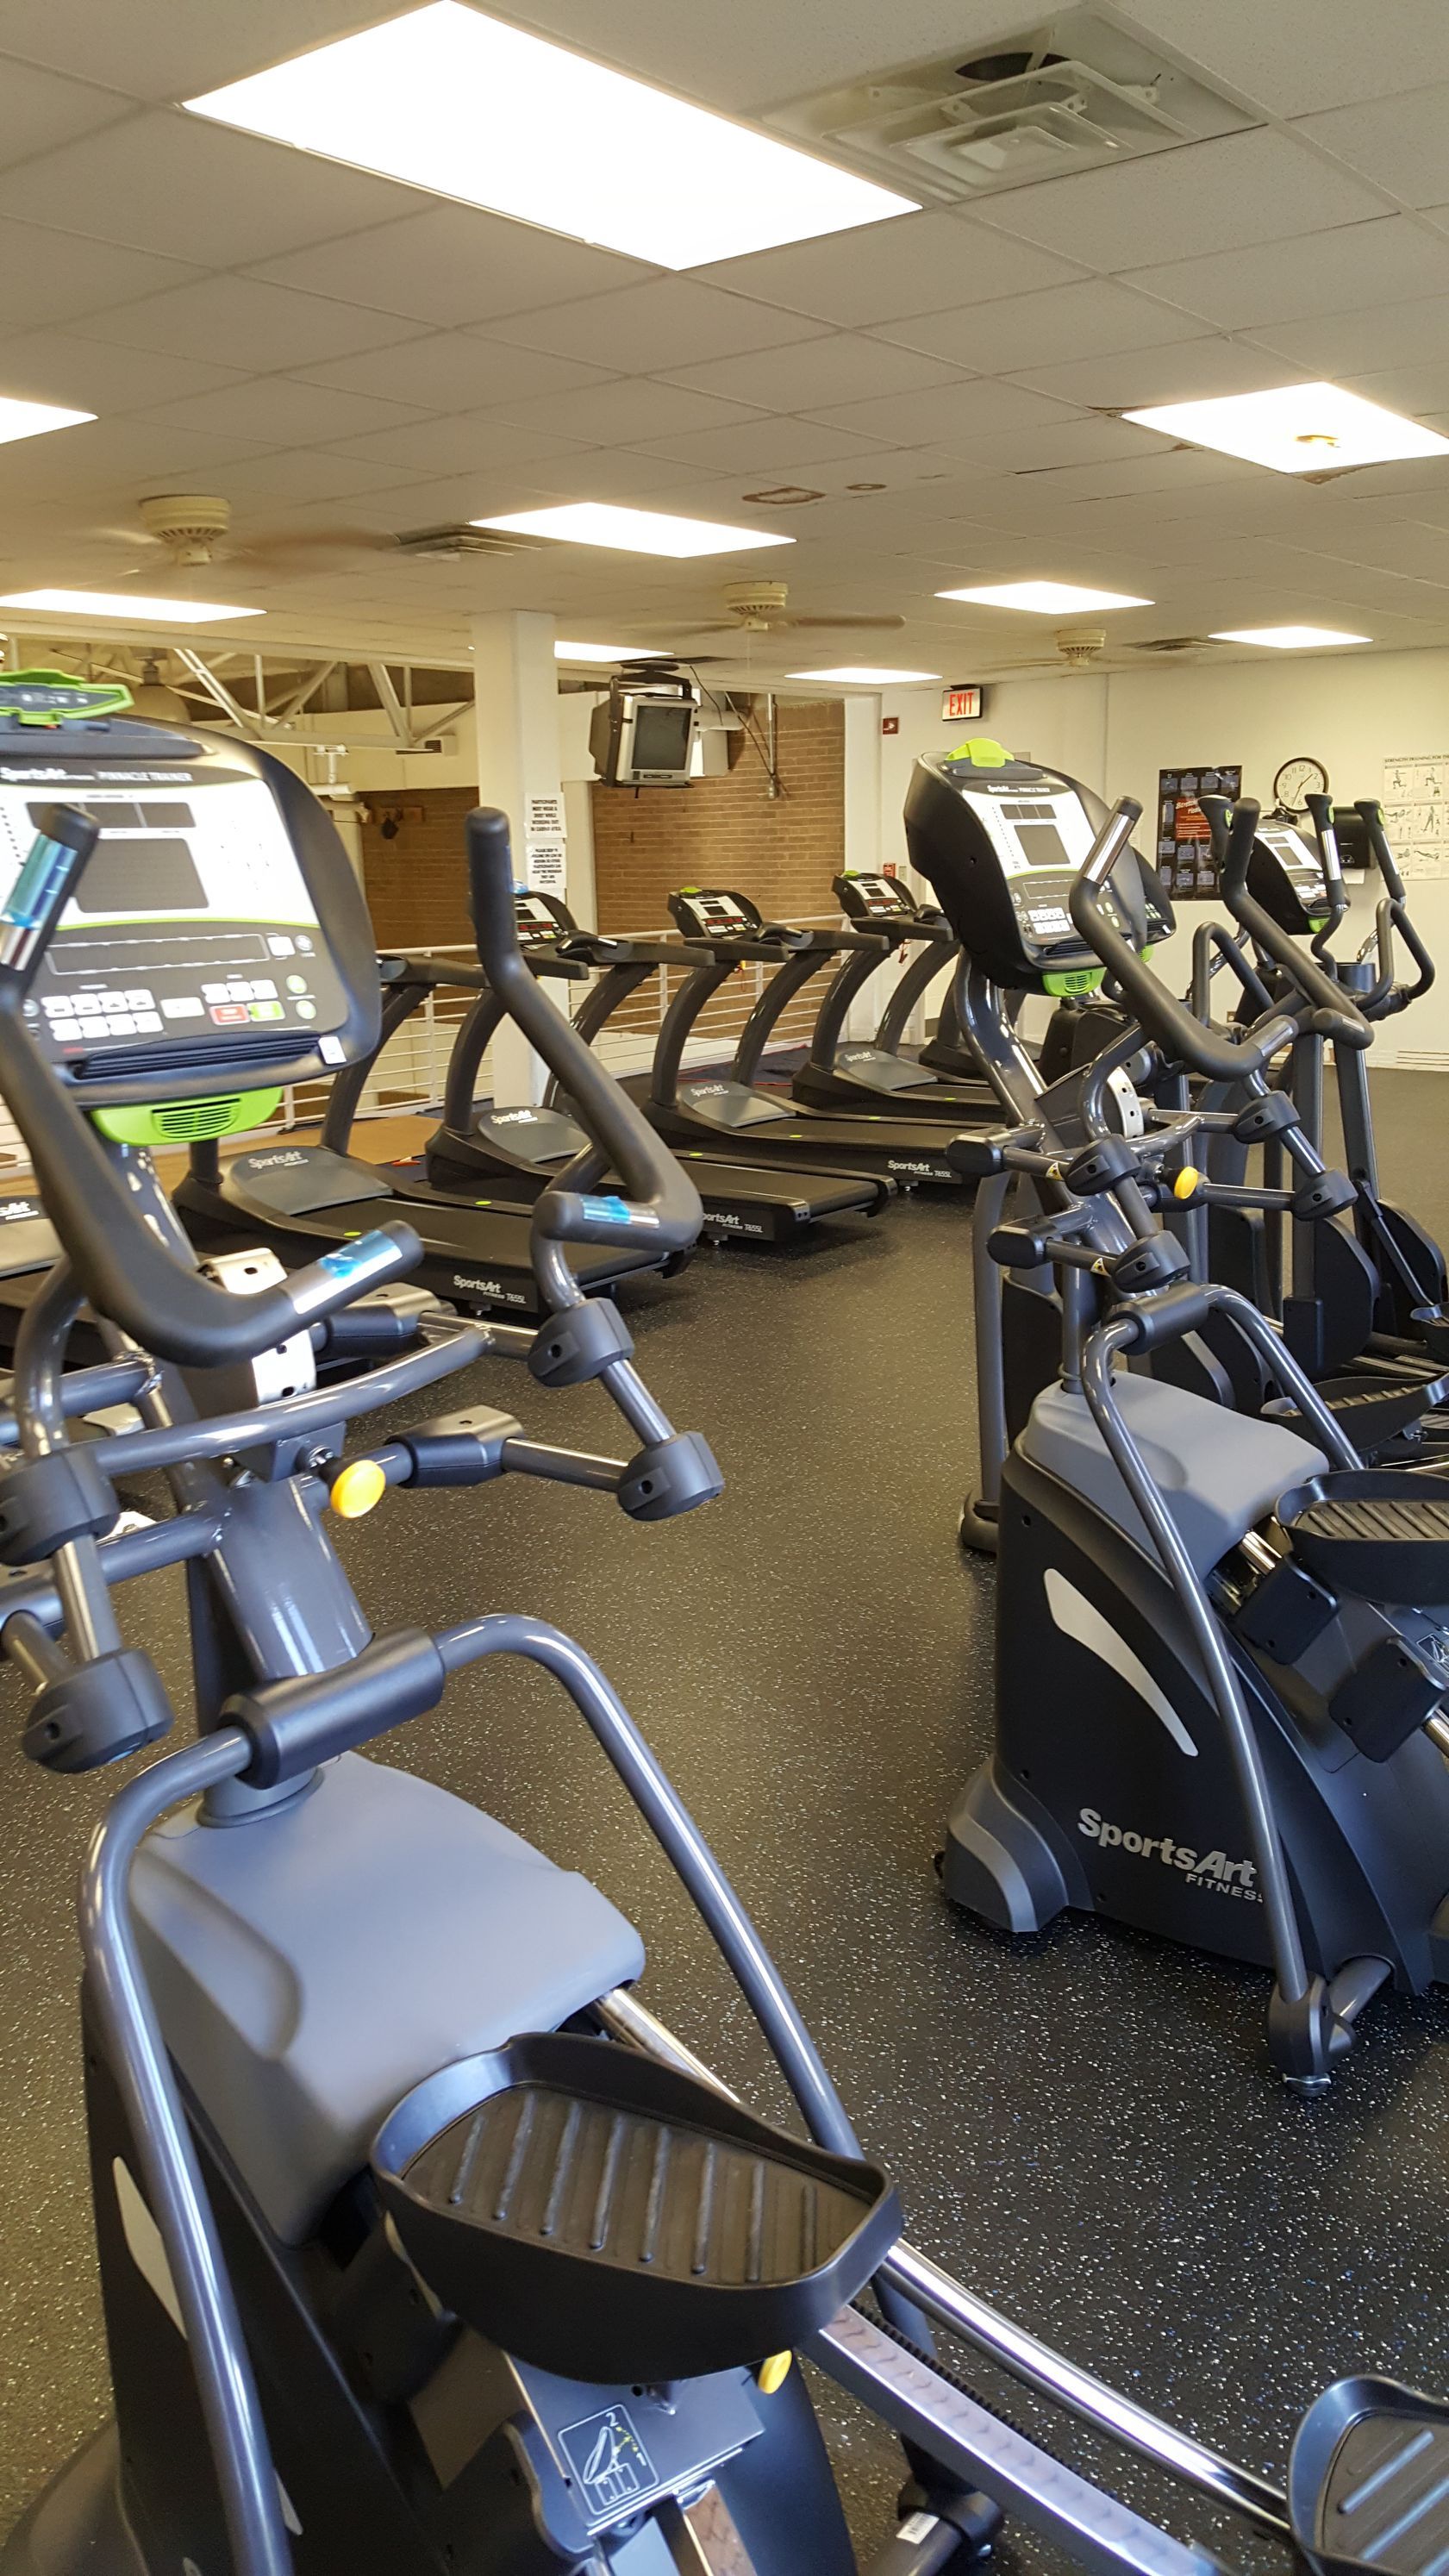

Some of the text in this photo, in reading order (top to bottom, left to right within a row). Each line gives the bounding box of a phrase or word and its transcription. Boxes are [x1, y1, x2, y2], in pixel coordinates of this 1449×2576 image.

[949, 692, 974, 716] EXIT
[490, 1110, 532, 1124] SportsArt
[248, 1151, 303, 1170] SportsArt
[887, 1160, 930, 1172] SportsArt
[703, 1212, 740, 1225] portsArt
[453, 1274, 502, 1293] SportsArt
[1077, 1807, 1258, 1888] SportsArt
[605, 2411, 620, 2427] 2
[636, 2452, 646, 2467] 1
